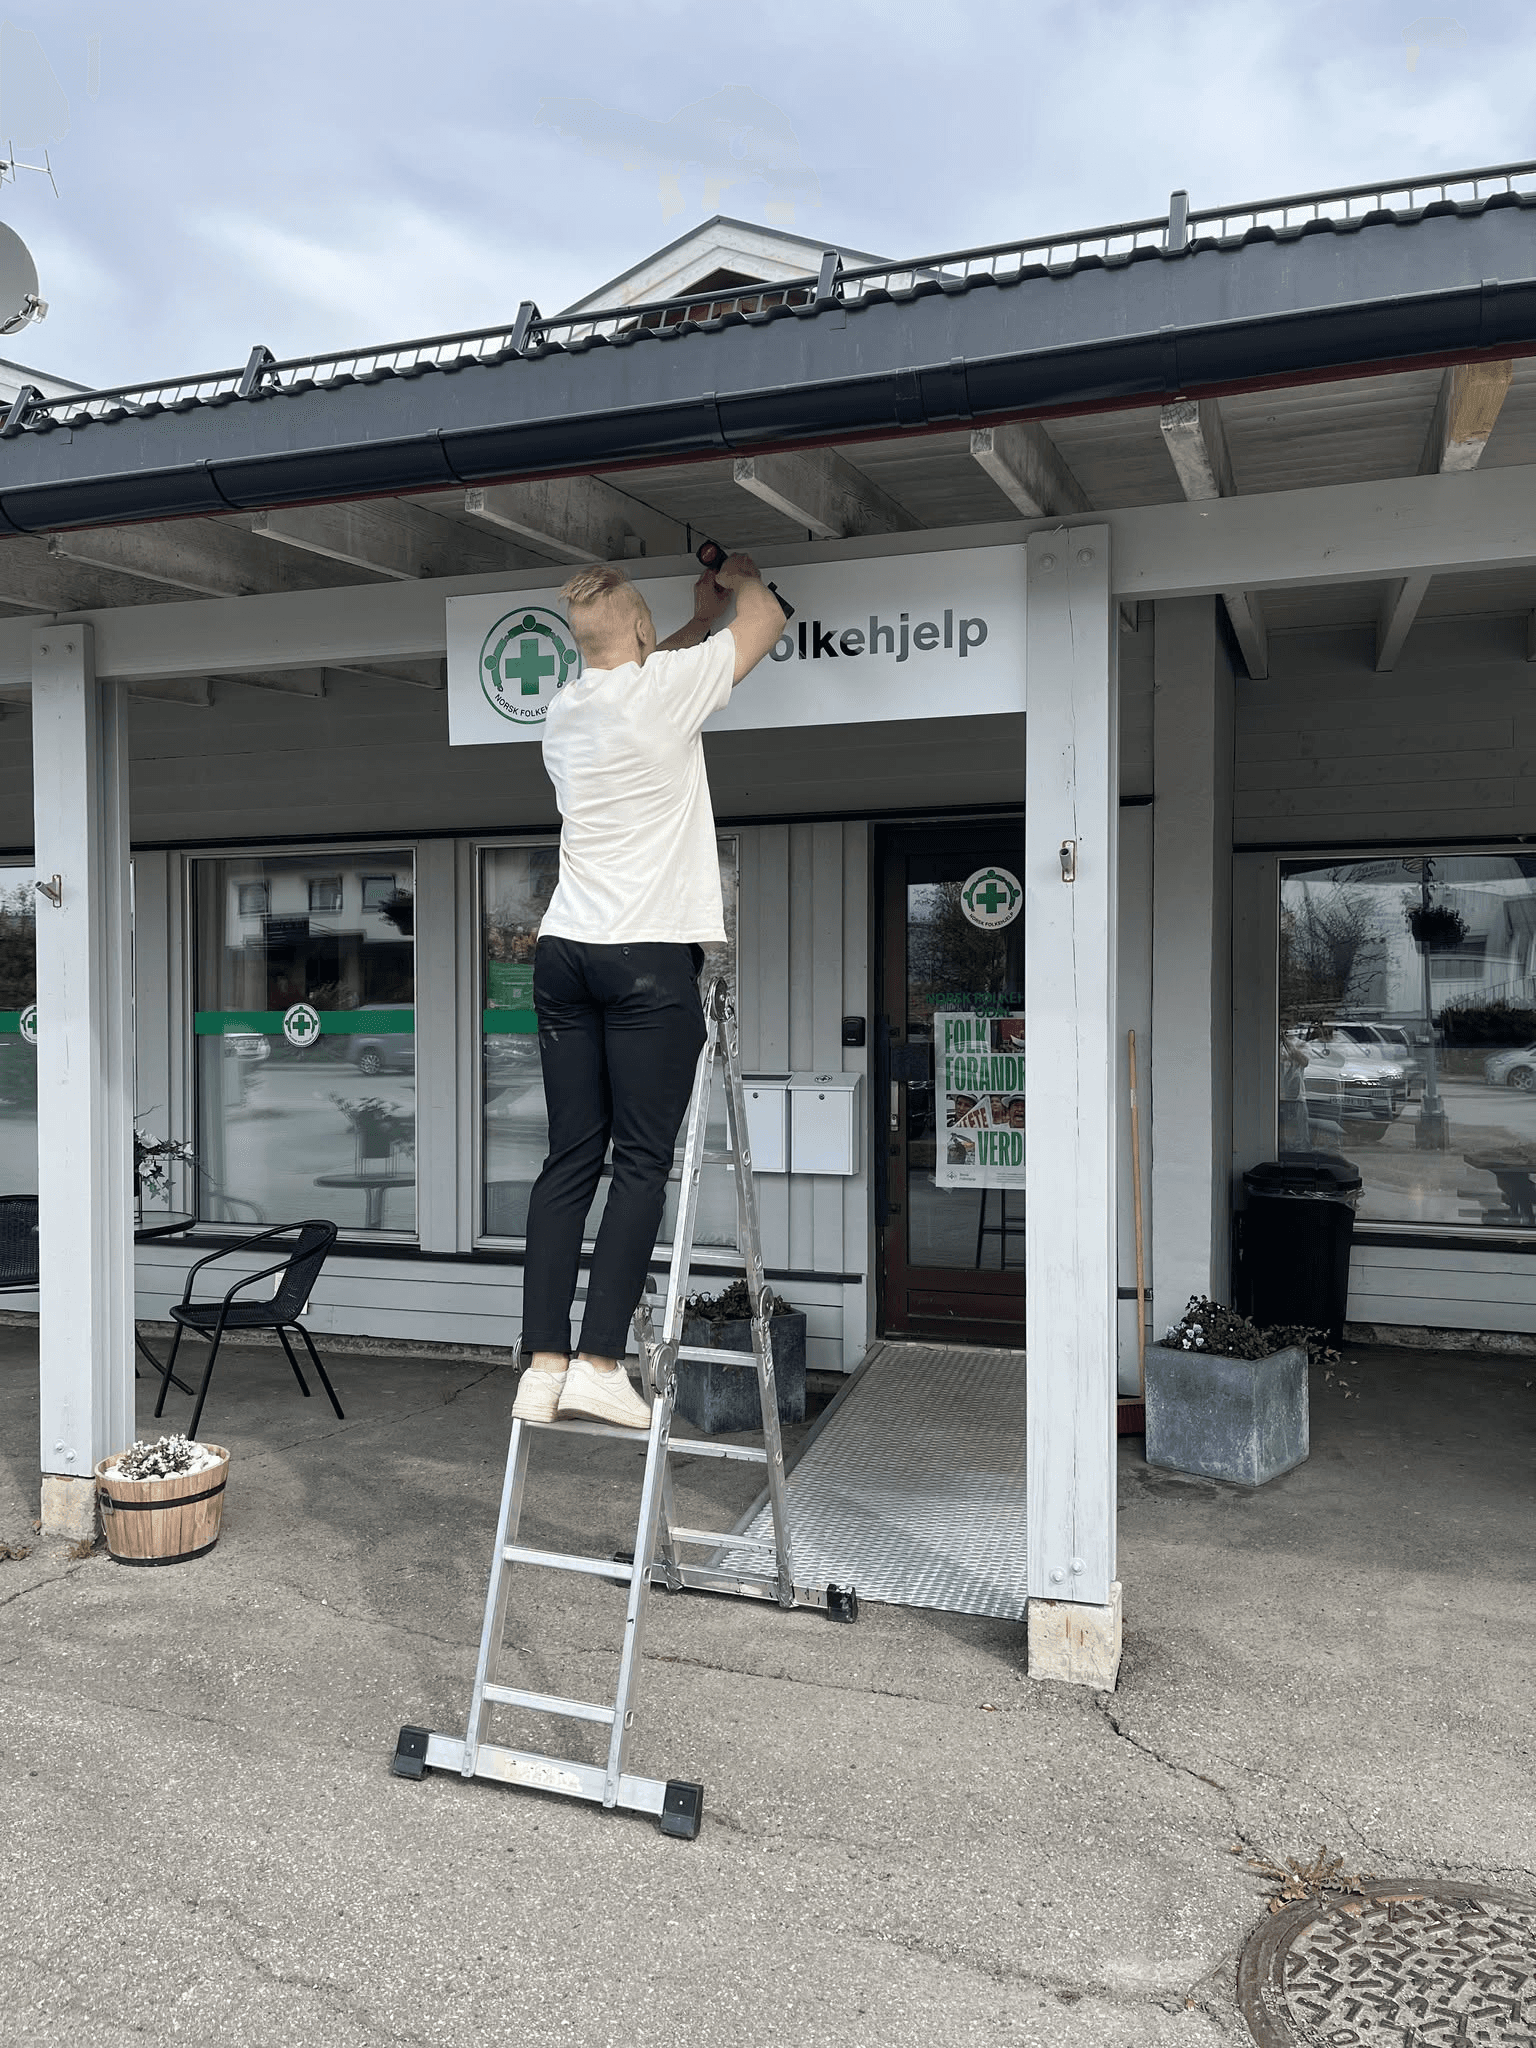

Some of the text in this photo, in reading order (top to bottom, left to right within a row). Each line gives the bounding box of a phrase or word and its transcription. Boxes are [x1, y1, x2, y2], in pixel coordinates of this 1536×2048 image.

[768, 609, 988, 662] olkehjelp
[494, 693, 519, 715] NORSK
[970, 912, 1014, 927] NORSK FOLKEHJELP
[926, 992, 971, 1006] NORSK
[975, 1006, 1014, 1018] ODAL
[944, 1019, 989, 1054] FOLK
[977, 1131, 1025, 1167] VERD
